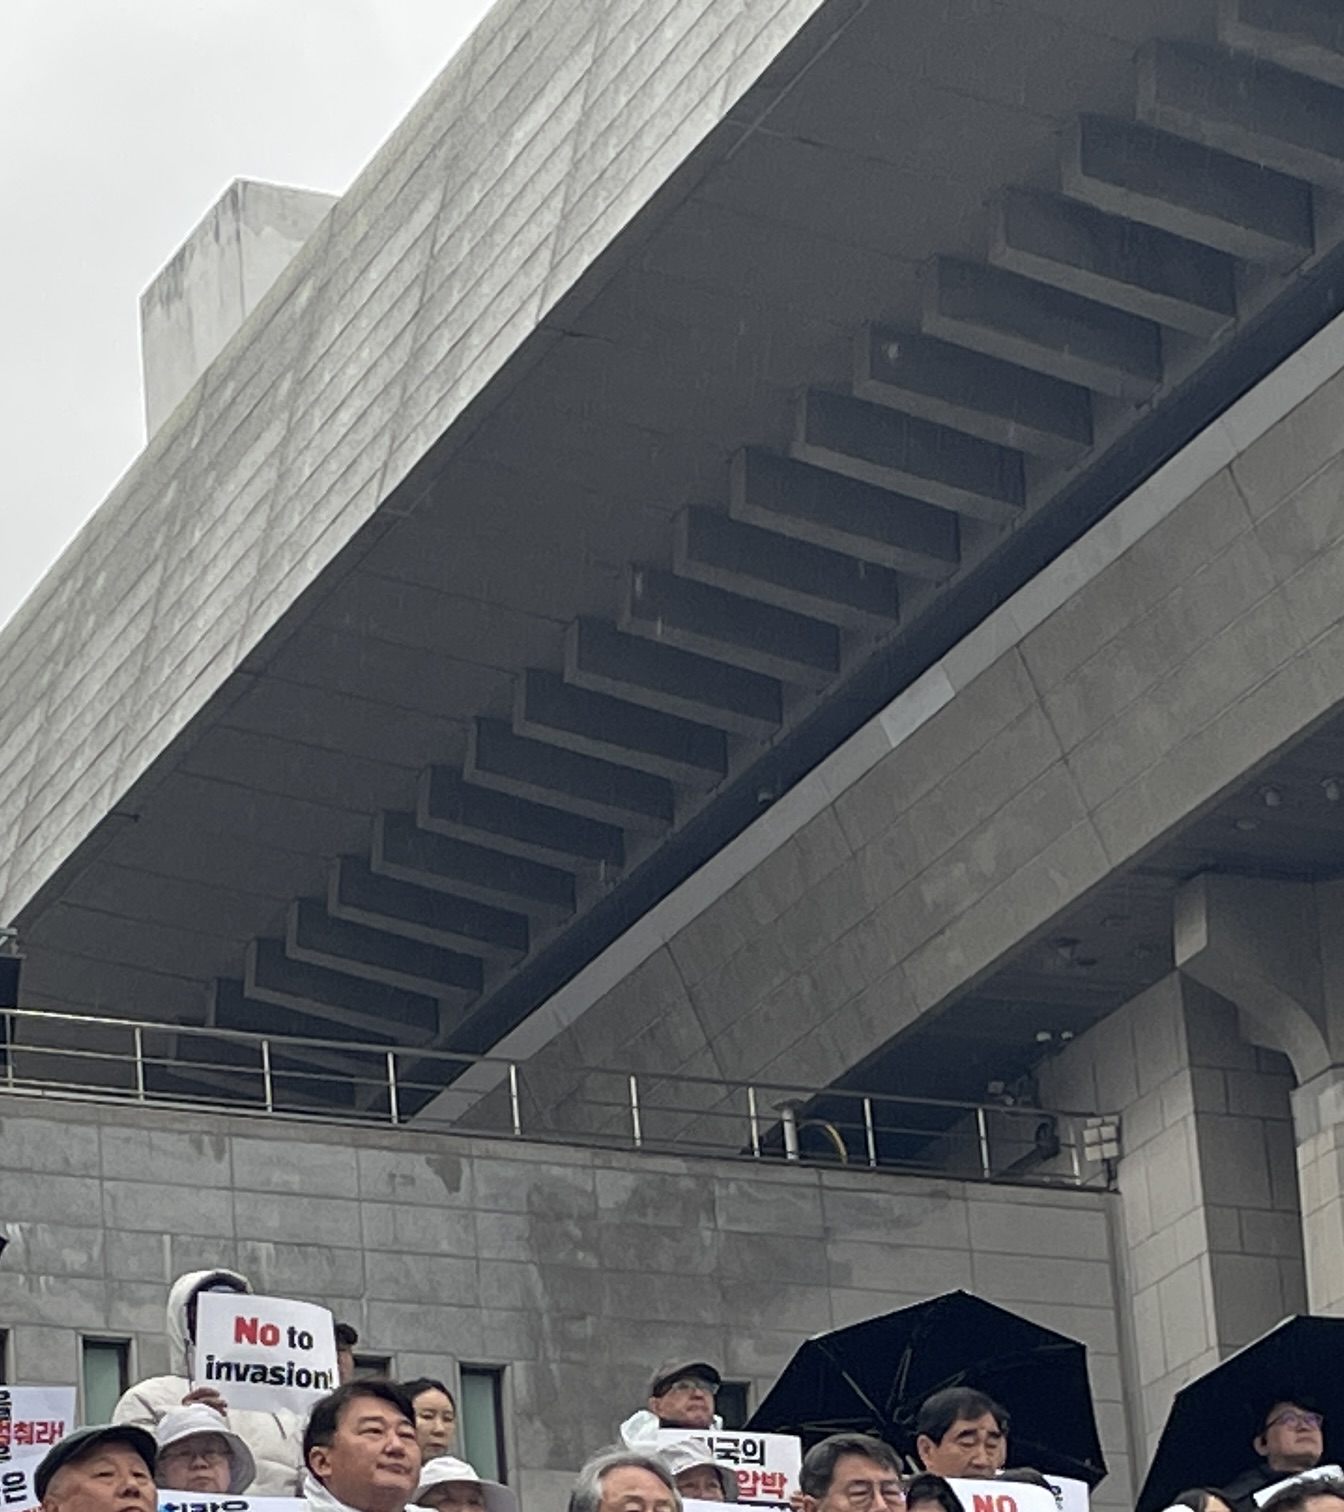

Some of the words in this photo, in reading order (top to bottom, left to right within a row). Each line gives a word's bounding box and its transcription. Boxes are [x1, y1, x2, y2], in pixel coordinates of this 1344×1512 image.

[234, 1316, 280, 1346] No
[287, 1326, 313, 1350] to
[205, 1355, 333, 1389] invasion!
[735, 1470, 788, 1499] 압박
